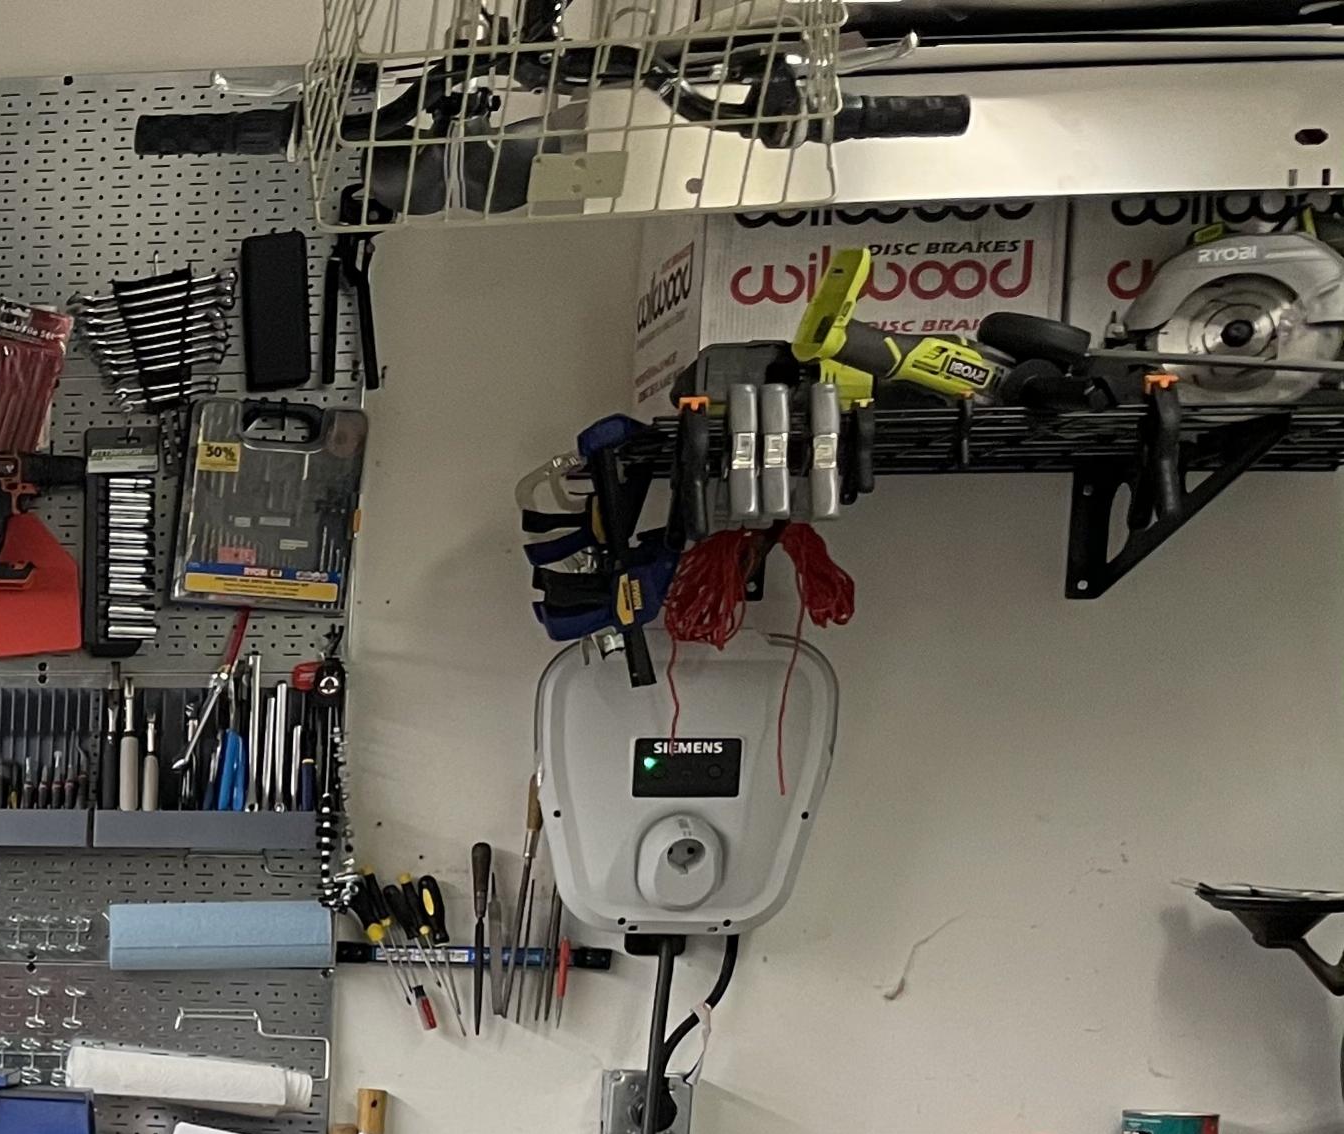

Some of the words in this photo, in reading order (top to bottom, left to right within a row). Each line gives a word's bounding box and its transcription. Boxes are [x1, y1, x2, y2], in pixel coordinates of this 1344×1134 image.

[868, 244, 917, 256] DISC
[925, 240, 1021, 254] BRAKES
[1198, 246, 1257, 263] RYOBI
[921, 319, 981, 332] BRAK
[949, 361, 988, 382] RYOBI
[653, 741, 723, 754] SIEMENS
